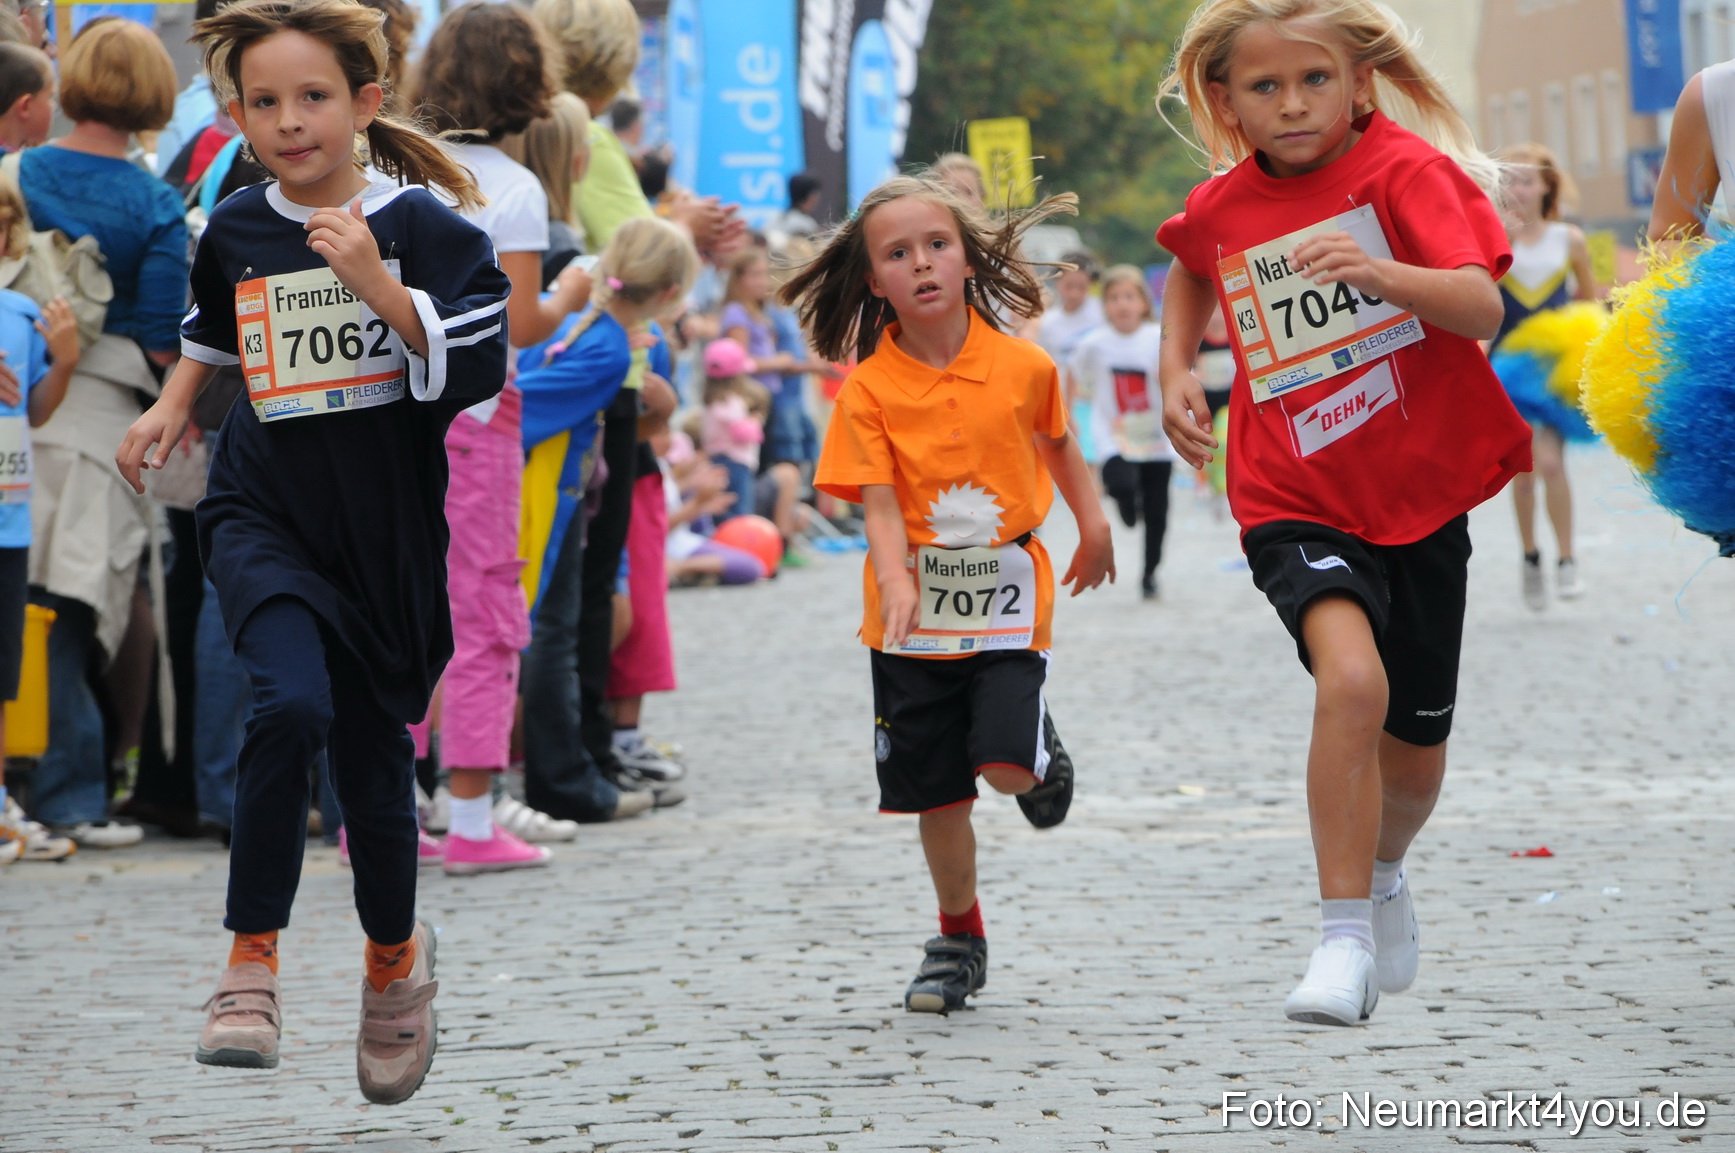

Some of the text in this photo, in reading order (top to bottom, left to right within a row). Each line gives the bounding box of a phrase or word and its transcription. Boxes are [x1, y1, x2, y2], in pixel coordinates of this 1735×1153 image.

[274, 281, 361, 313] Franzis
[1237, 309, 1257, 333] K3
[245, 333, 263, 355] K3
[282, 319, 392, 369] 7062
[1351, 320, 1417, 356] PFLEIDERER
[346, 379, 404, 400] PFLEIDERER
[1267, 367, 1309, 390] BOCK
[264, 399, 300, 413] BOCK
[1321, 391, 1366, 432] DEHN
[925, 554, 999, 577] Marlene
[929, 584, 1021, 617] 7072
[976, 634, 1029, 645] PFLEIDERER
